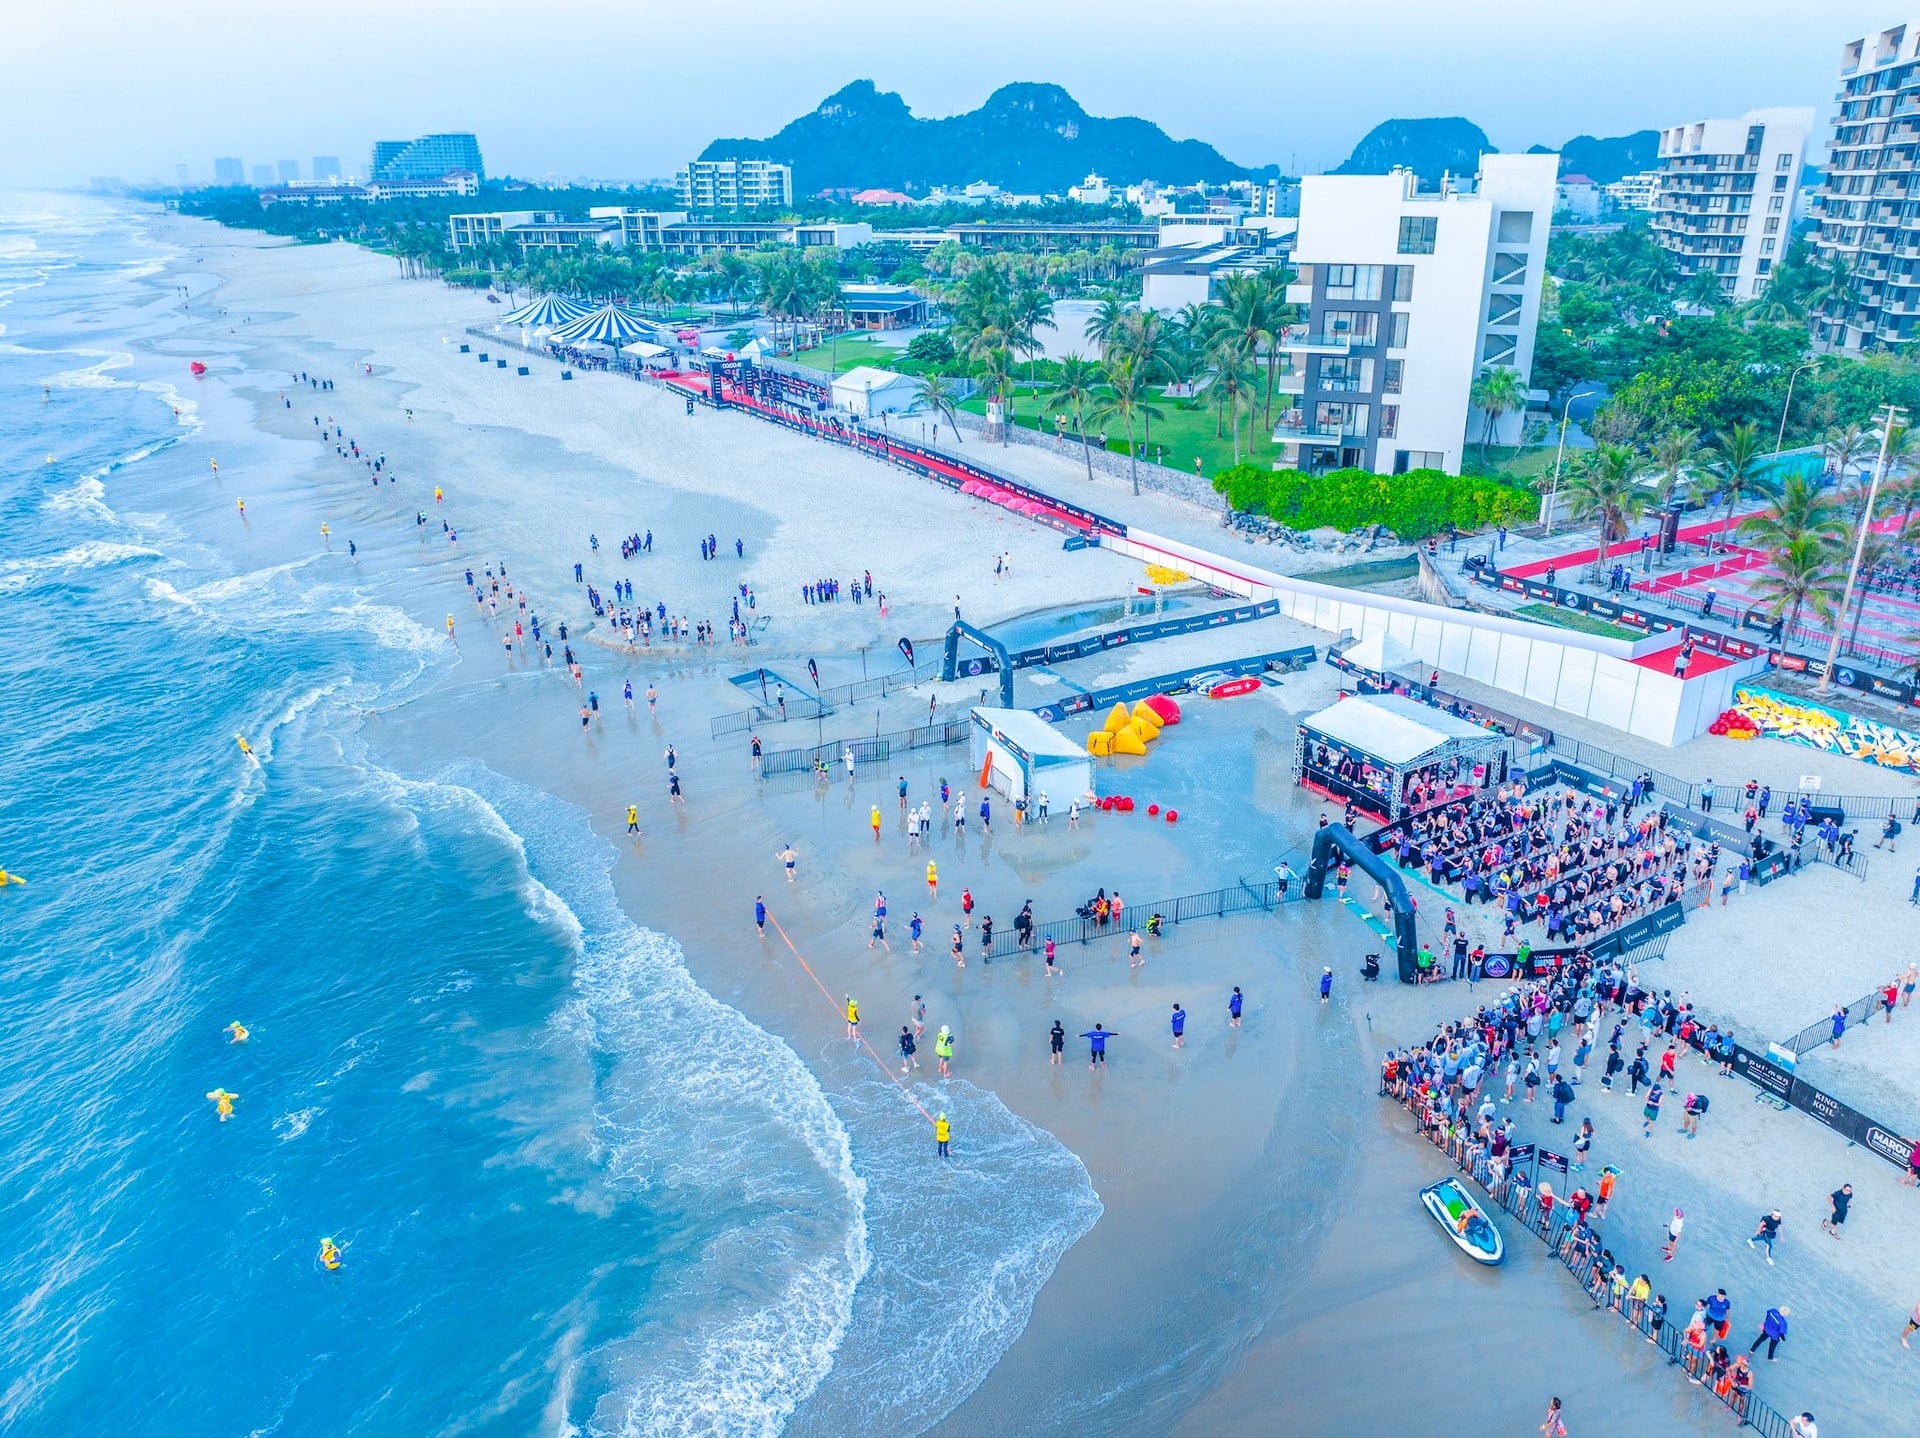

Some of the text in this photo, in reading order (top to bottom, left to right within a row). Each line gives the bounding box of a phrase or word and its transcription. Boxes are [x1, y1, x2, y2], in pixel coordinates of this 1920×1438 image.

[1673, 815, 1697, 828] VINFAST
[1716, 831, 1741, 845] VINFAST
[1812, 1100, 1835, 1117] KOIL
[1815, 1091, 1838, 1109] KING
[1873, 1130, 1911, 1159] MAROU
